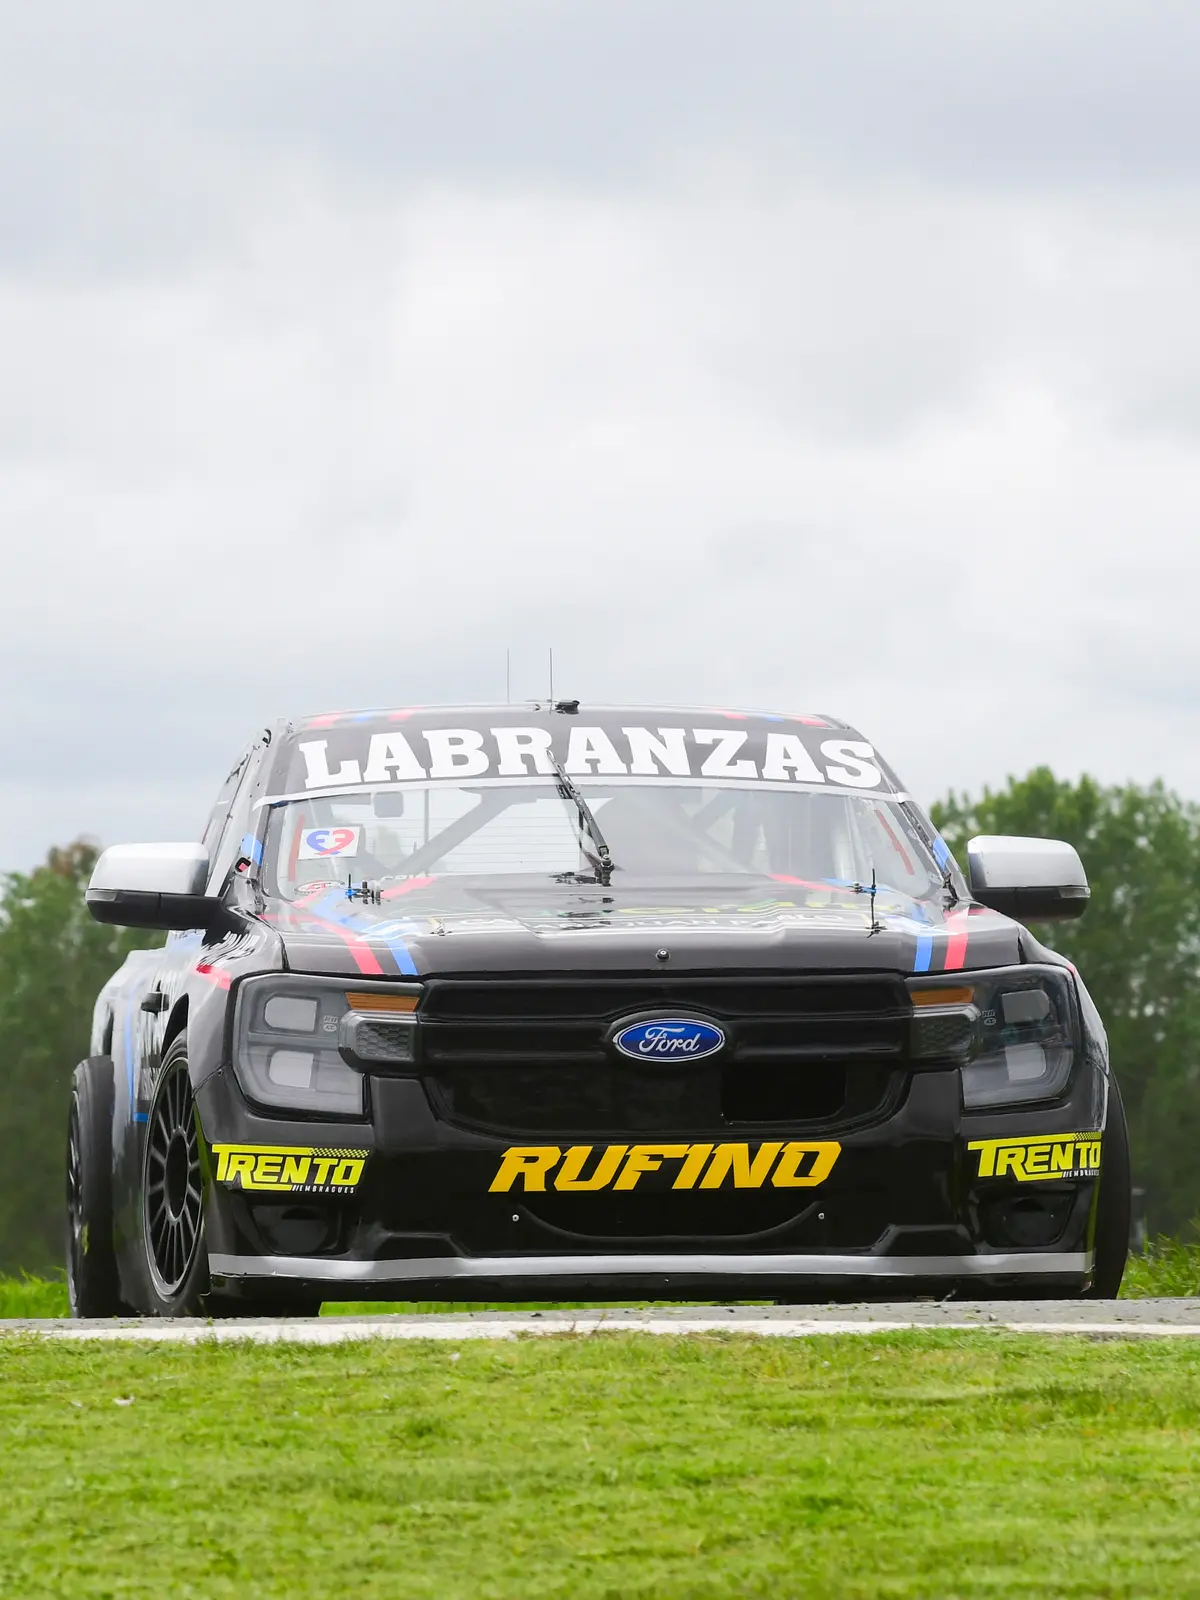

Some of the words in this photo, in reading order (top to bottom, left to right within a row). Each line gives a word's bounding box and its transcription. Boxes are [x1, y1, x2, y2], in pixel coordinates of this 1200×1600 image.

[298, 726, 882, 789] LABRANZAS
[638, 1026, 701, 1052] Ford
[212, 1144, 366, 1191] TRENTO
[488, 1141, 842, 1193] RUFINO
[968, 1132, 1102, 1182] TRENTO
